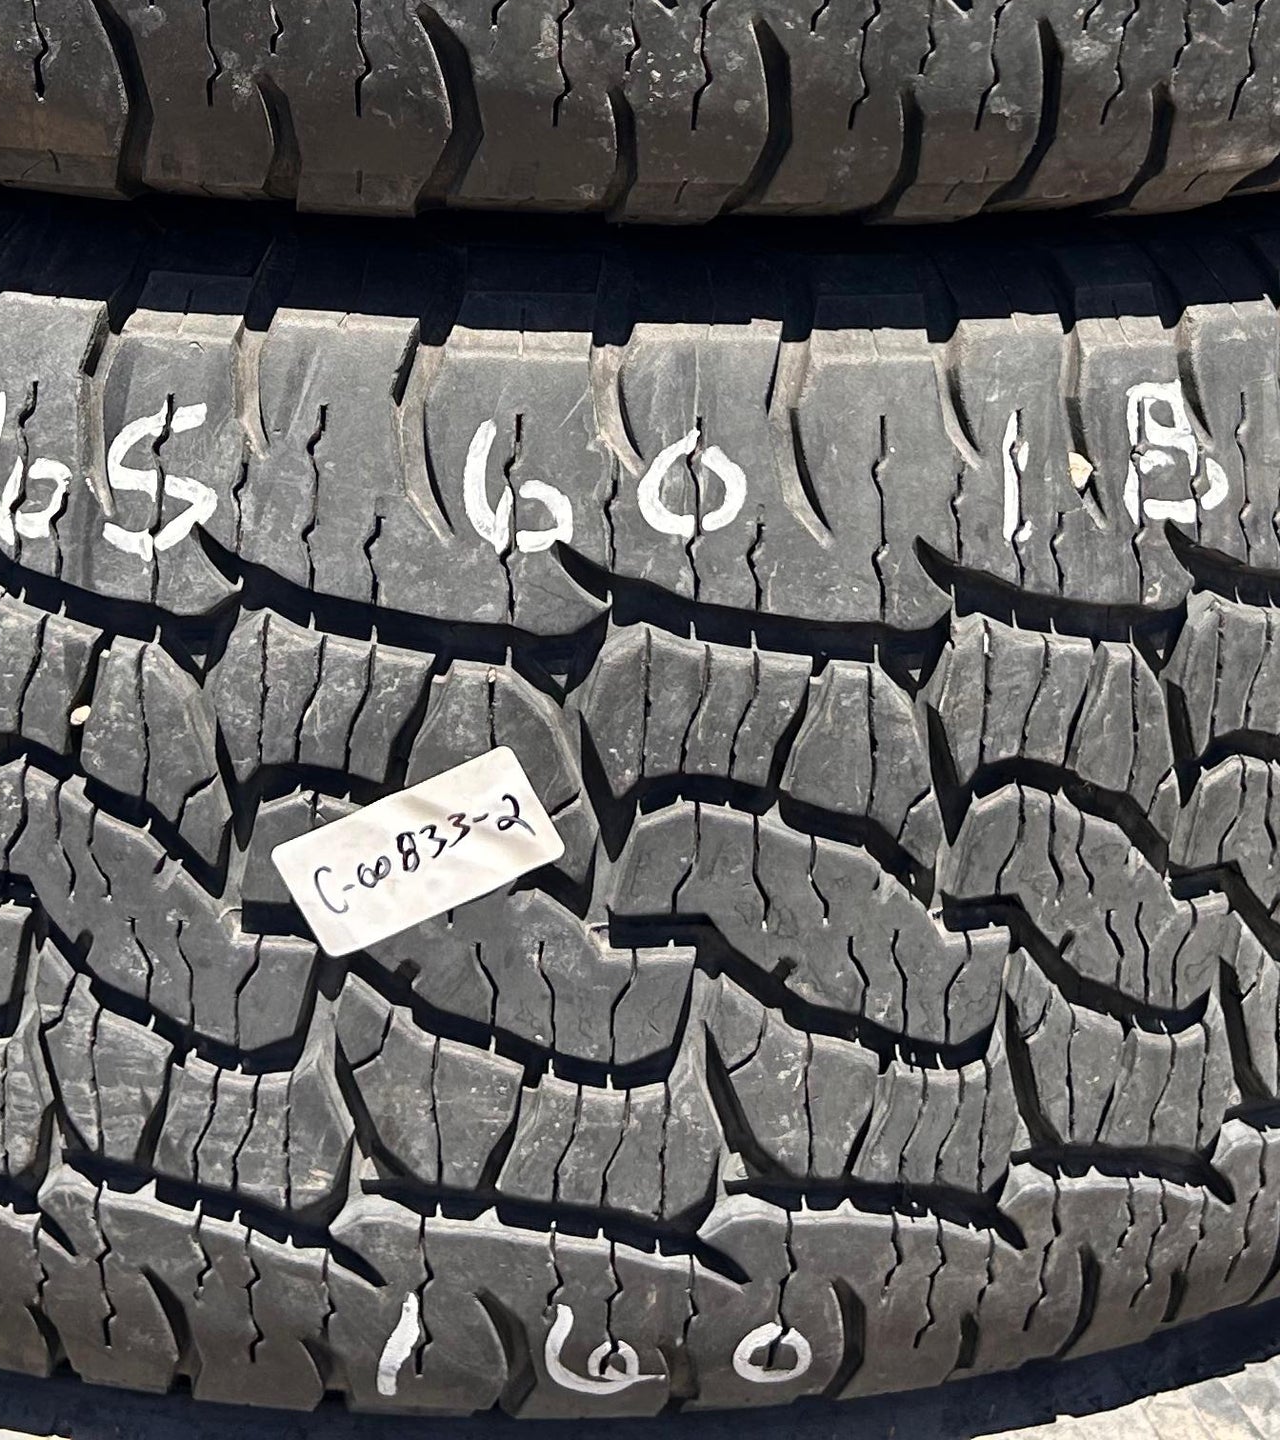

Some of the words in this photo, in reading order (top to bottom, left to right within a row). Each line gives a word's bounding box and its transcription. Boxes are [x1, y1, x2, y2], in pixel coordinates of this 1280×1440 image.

[462, 416, 746, 552] 60
[1000, 378, 1231, 544] 18
[312, 792, 538, 915] C-00833-2
[376, 1290, 813, 1396] 160
